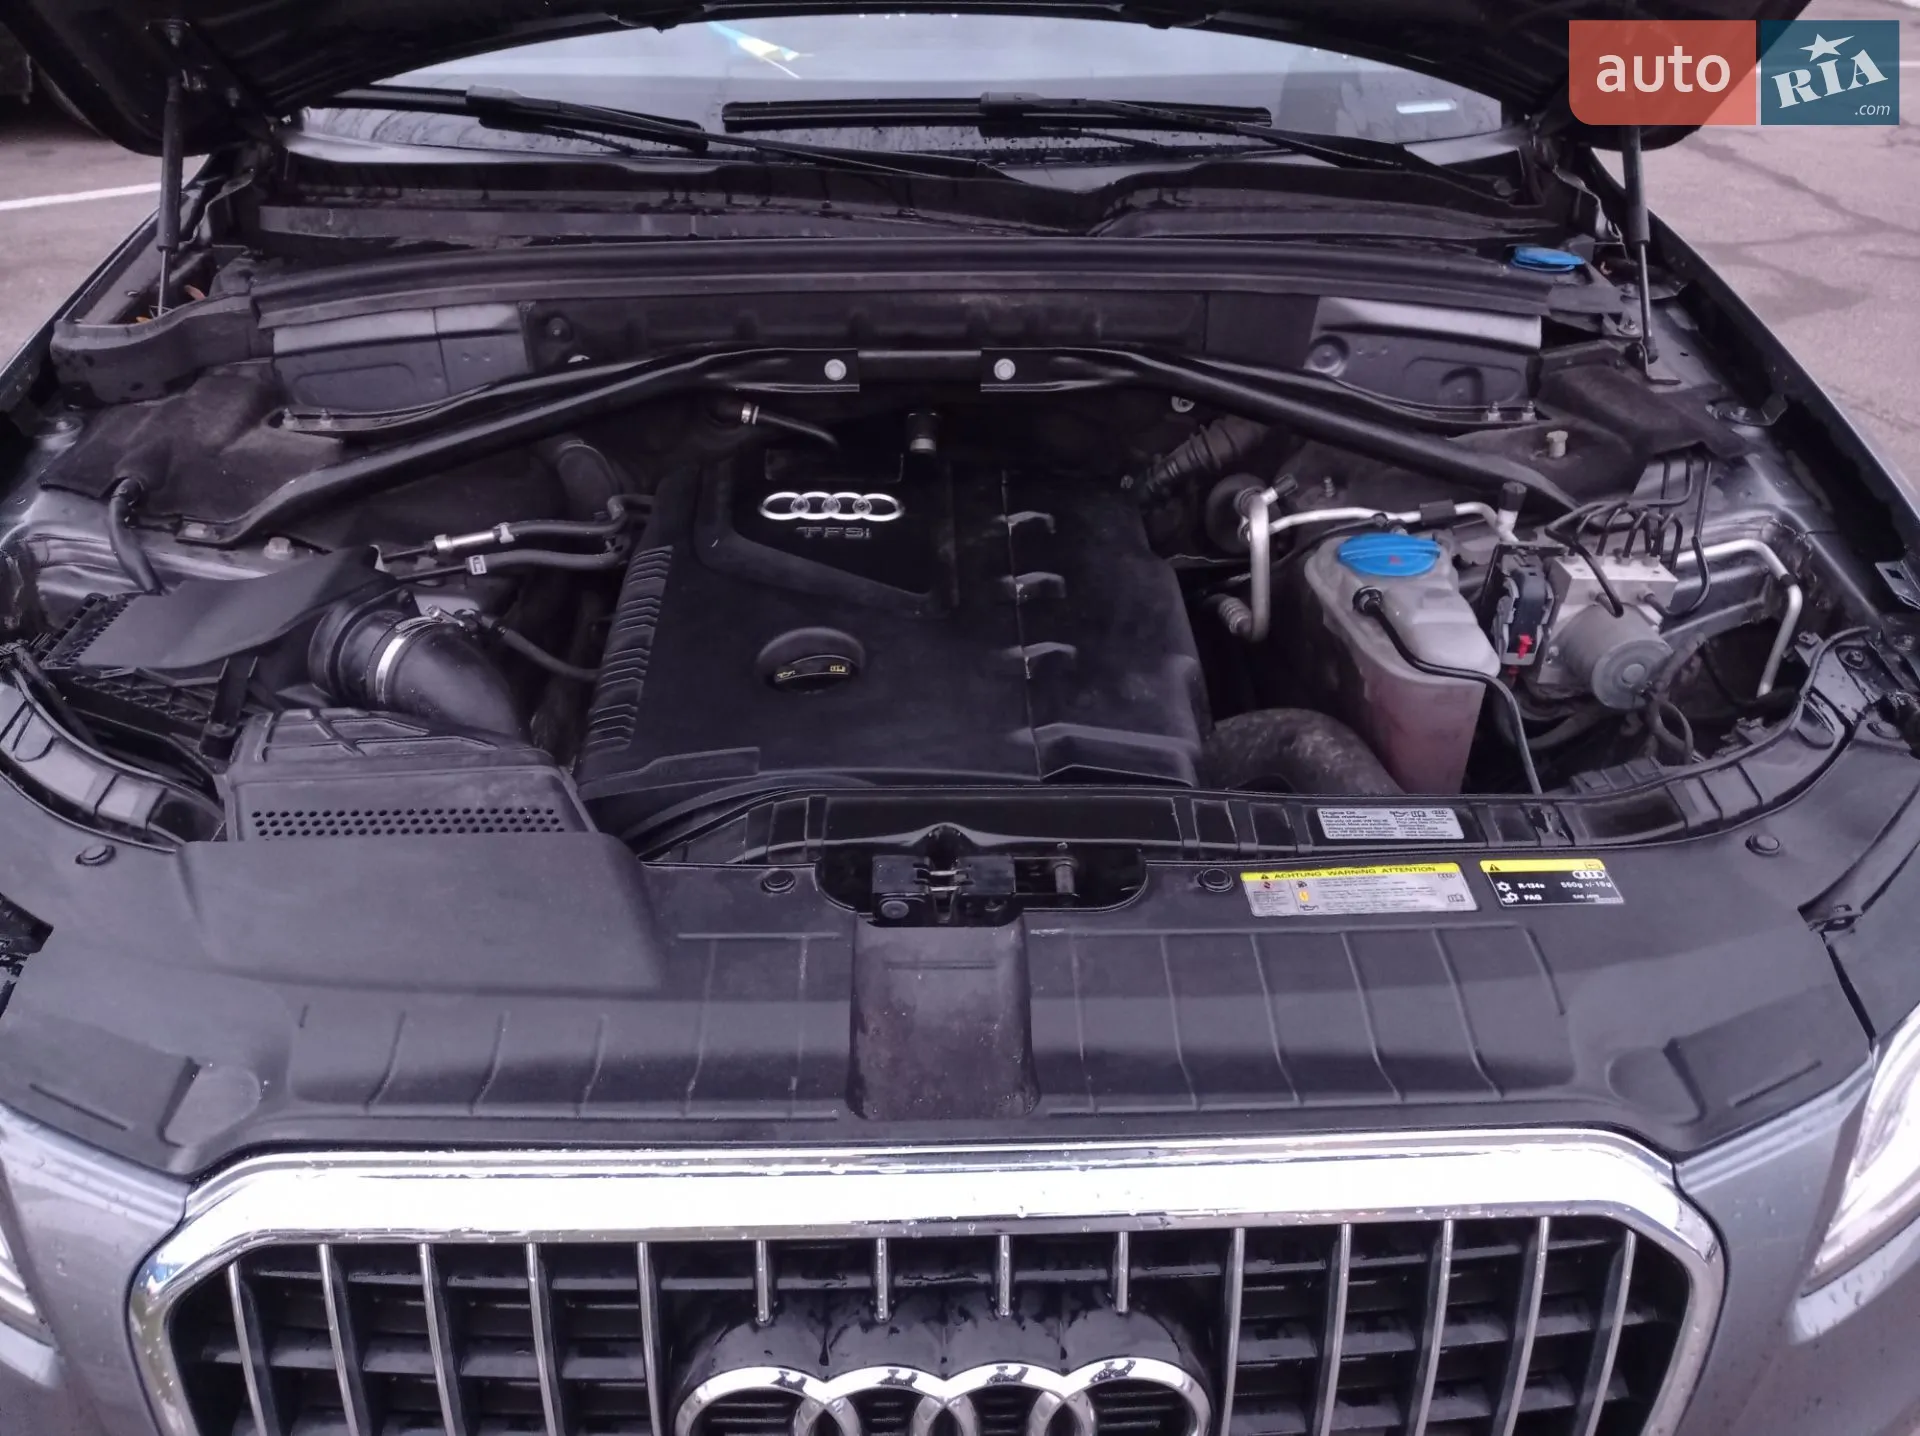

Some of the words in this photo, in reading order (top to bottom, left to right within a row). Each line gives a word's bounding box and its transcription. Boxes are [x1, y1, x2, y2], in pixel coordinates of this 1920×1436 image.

[1274, 870, 1322, 879] ACHTUNG
[1327, 868, 1377, 876] WARNING
[1381, 866, 1436, 874] ATTENTION
